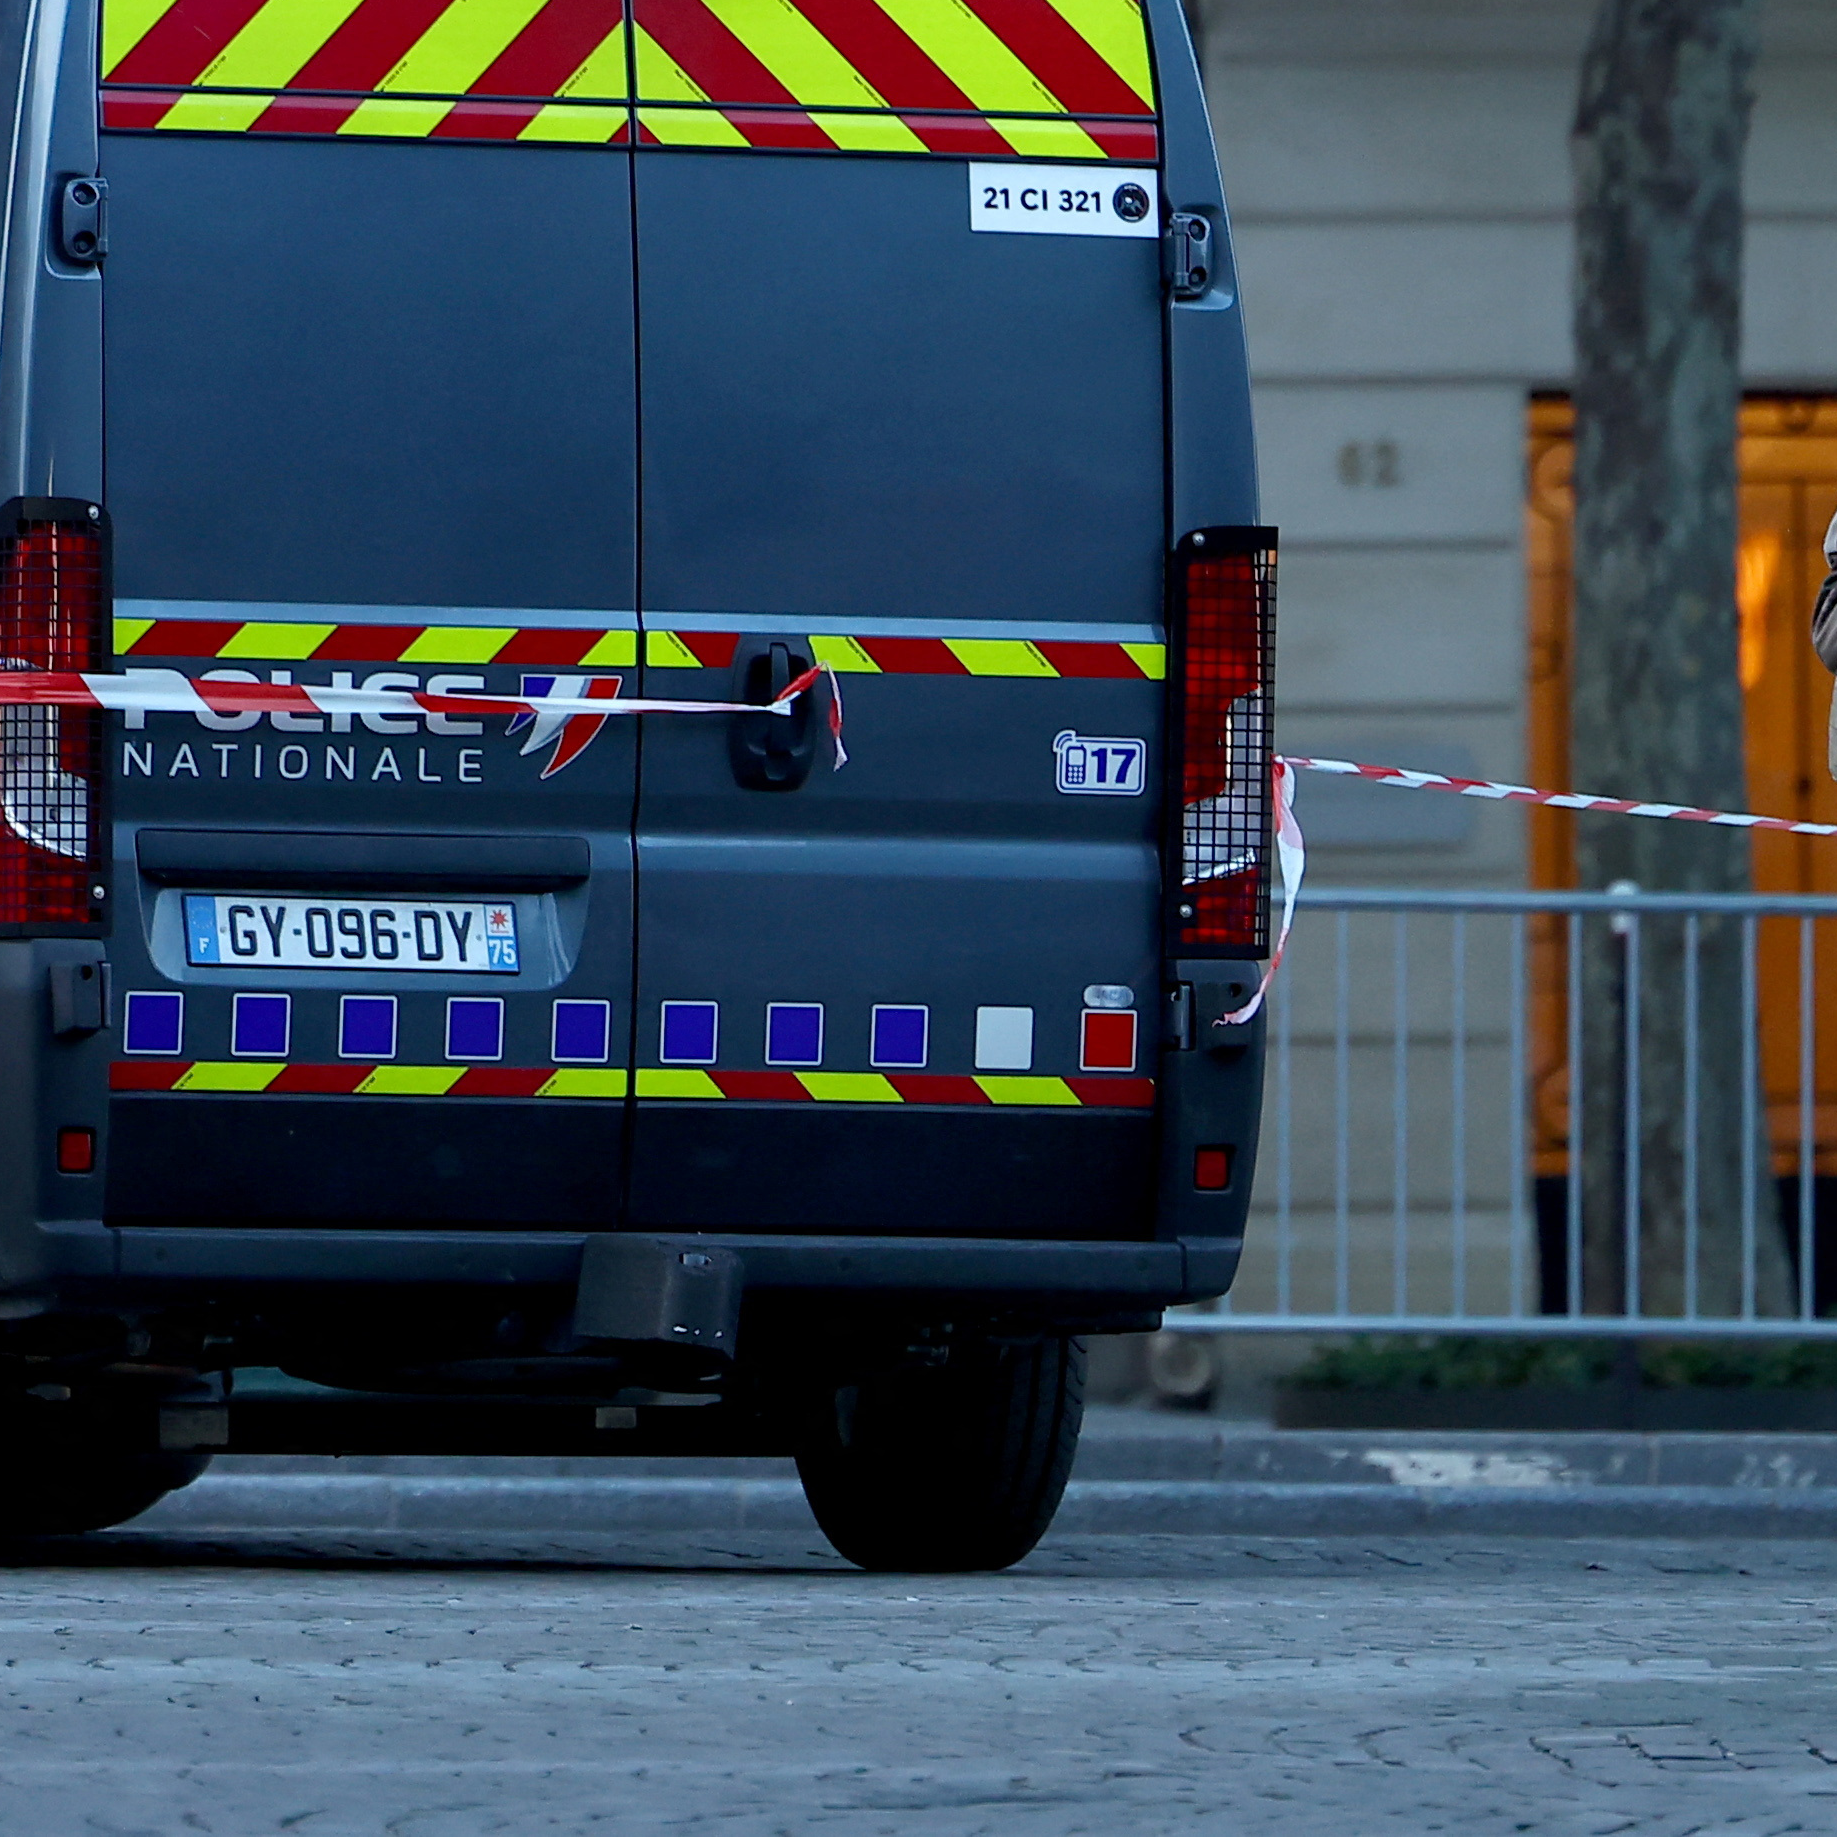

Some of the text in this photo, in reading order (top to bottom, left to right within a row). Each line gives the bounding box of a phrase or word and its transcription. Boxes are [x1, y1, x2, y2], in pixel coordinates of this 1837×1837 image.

[983, 186, 1102, 214] 21 CI 321
[122, 741, 483, 783] NATIONALE
[1090, 747, 1137, 784] 17
[198, 937, 210, 954] F
[228, 904, 473, 963] GY-096-DY
[488, 939, 517, 965] 75
